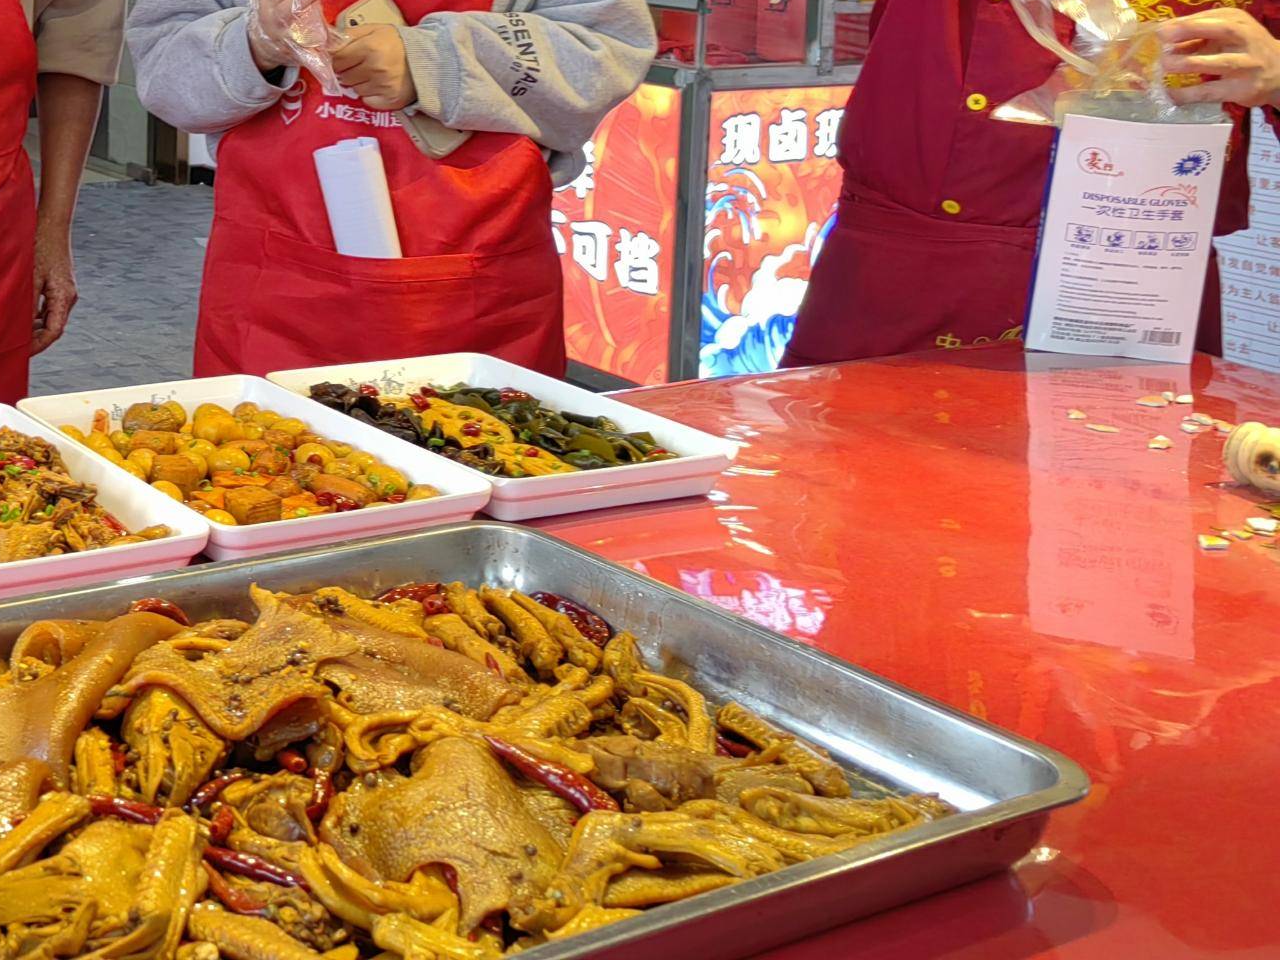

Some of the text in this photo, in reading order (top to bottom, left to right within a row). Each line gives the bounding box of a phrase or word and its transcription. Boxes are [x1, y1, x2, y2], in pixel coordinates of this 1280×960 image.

[1083, 191, 1188, 207] DISPOSABLE GLOVES
[1081, 205, 1184, 221] 一次性卫生手套
